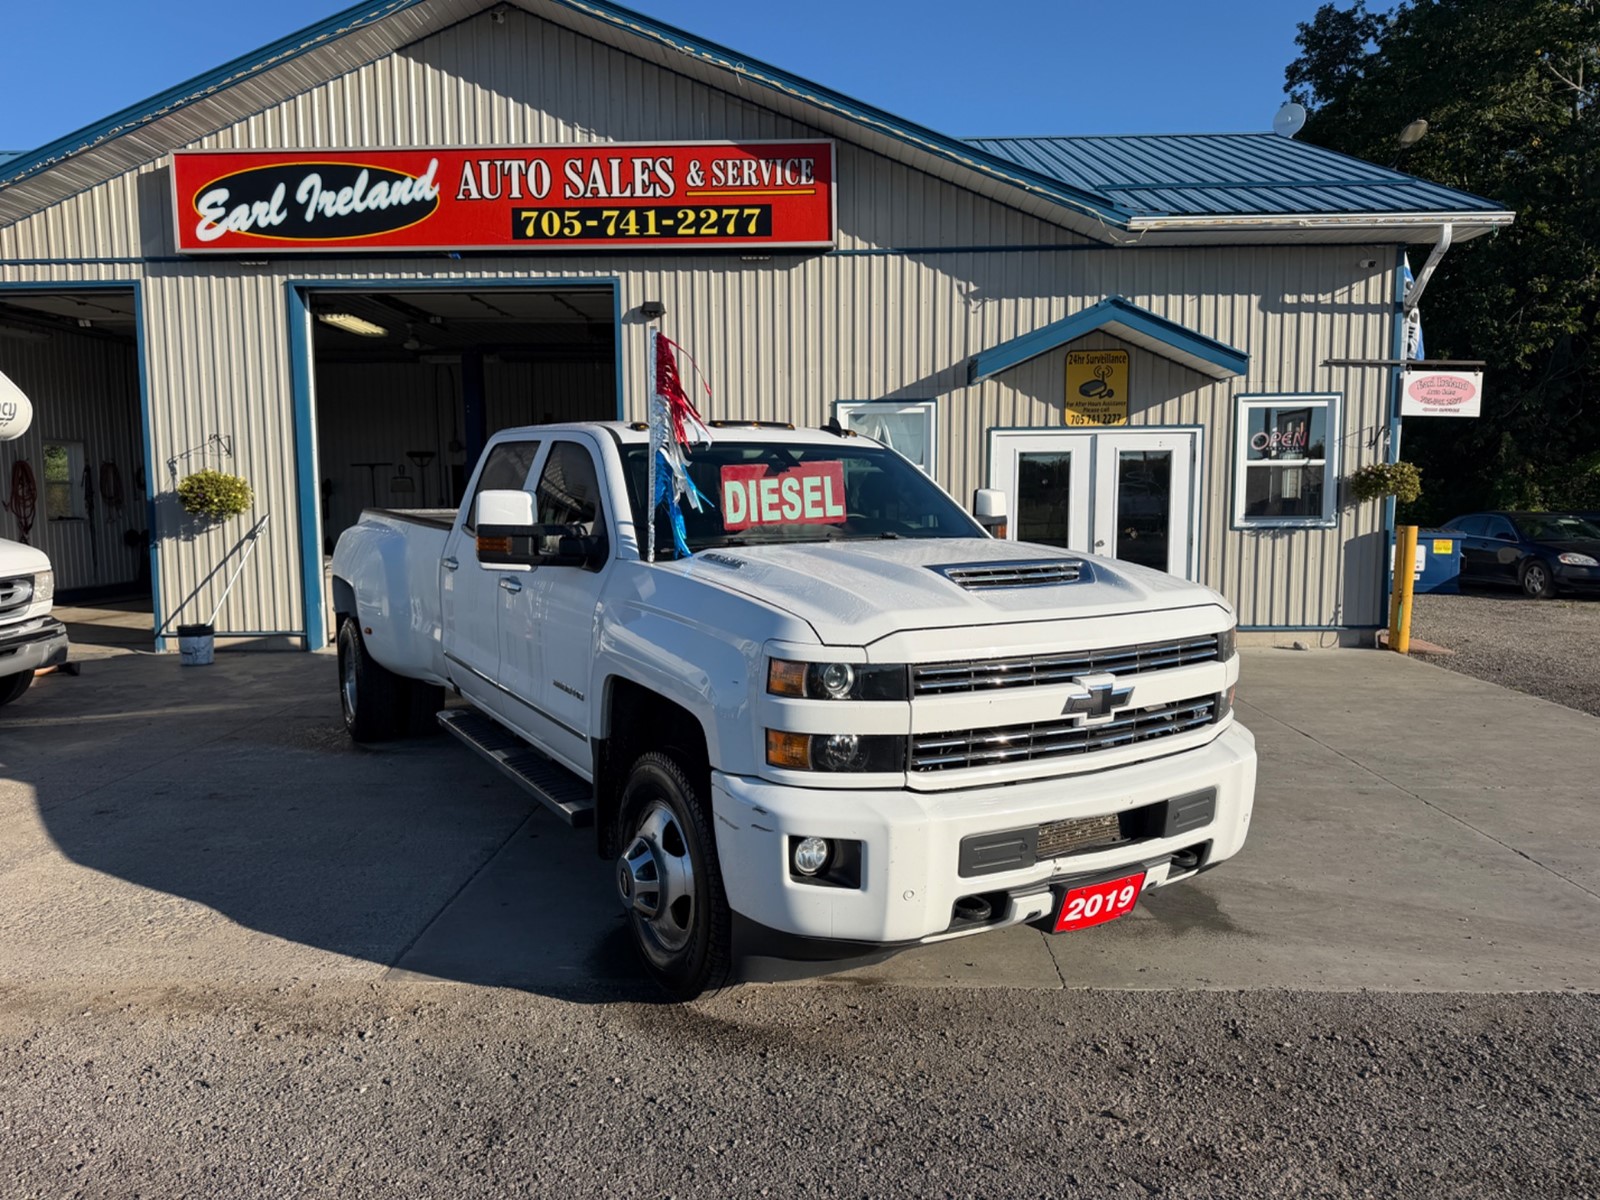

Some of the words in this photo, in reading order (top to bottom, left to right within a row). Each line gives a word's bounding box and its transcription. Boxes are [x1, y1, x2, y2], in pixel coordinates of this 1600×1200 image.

[456, 158, 553, 201] AUTO
[564, 156, 677, 199] SALES
[686, 159, 706, 187] &
[711, 157, 816, 187] SERVICE
[195, 182, 288, 242] Earl
[296, 157, 440, 223] Ireland
[519, 207, 762, 238] 705-741-2277
[1068, 354, 1085, 365] 24hr
[1086, 353, 1127, 365] Surveillance
[1071, 414, 1085, 425] 705
[1087, 414, 1100, 424] 741
[1102, 413, 1121, 425] 2277
[1251, 431, 1308, 451] OPEN
[724, 476, 844, 524] DIESEL
[1064, 885, 1135, 922] 2019
